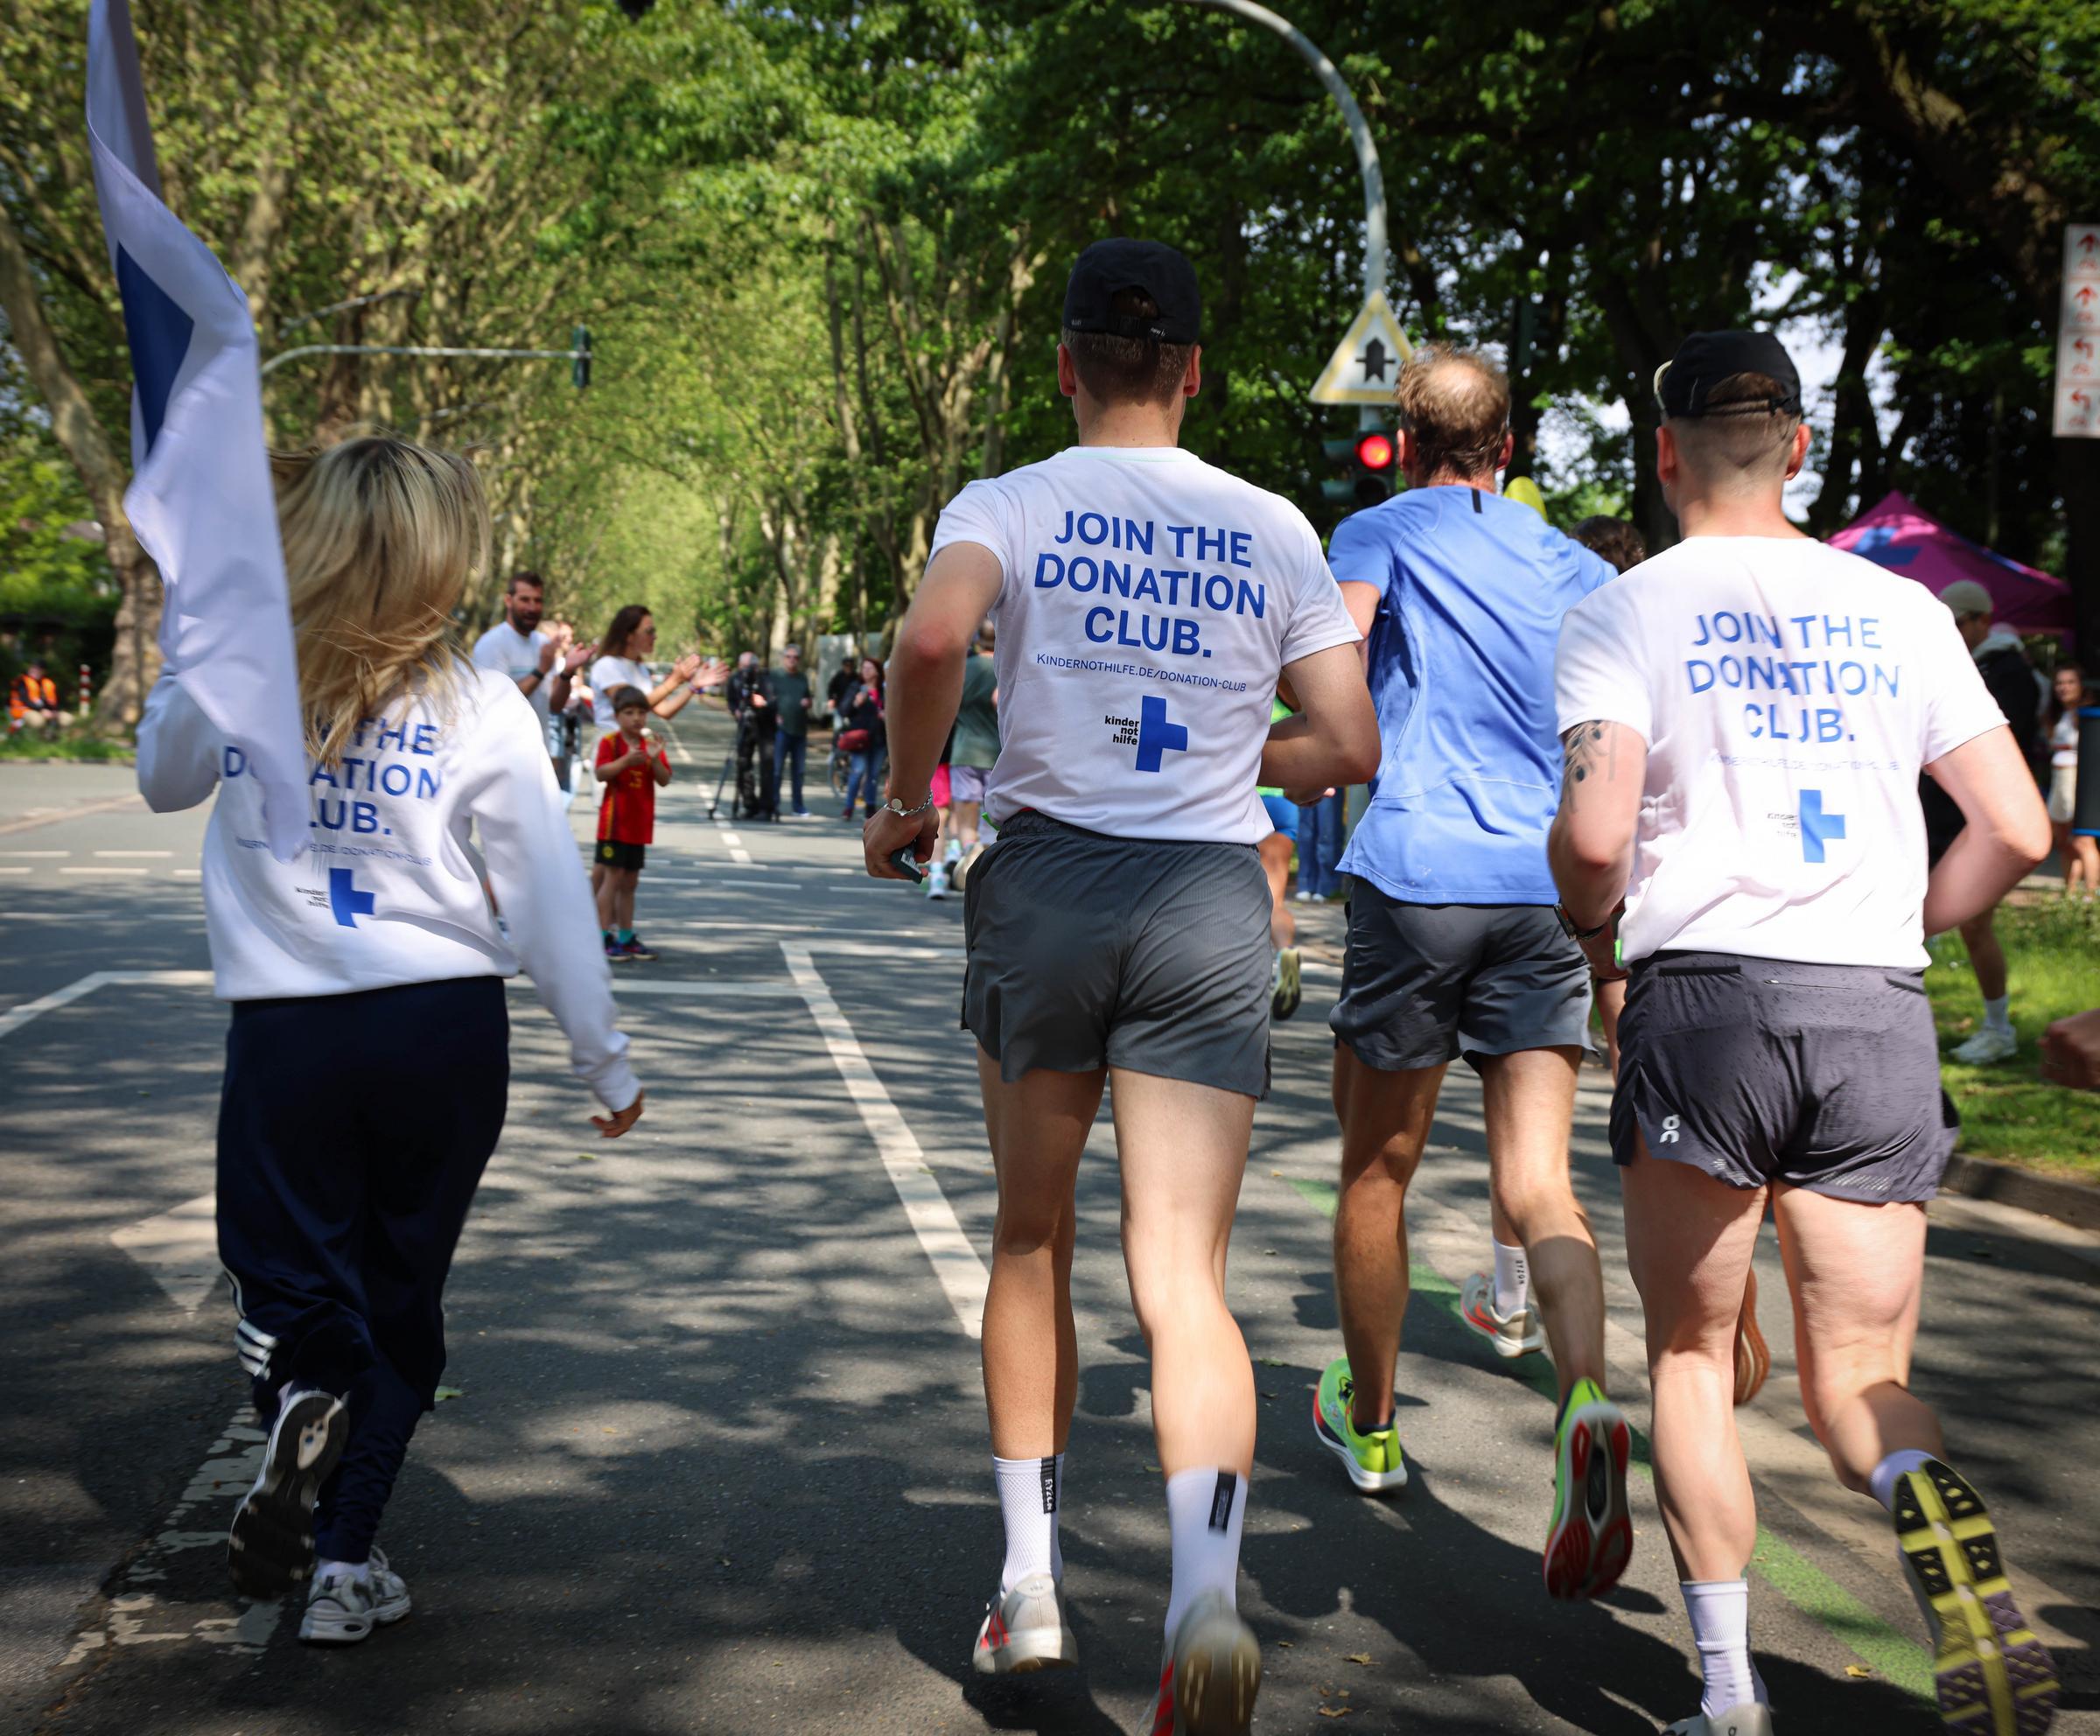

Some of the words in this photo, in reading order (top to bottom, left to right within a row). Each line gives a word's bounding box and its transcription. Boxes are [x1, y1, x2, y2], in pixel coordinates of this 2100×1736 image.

[1054, 510, 1154, 555] JOIN
[1166, 525, 1252, 568] THE
[1034, 553, 1265, 619] DONATION
[1085, 606, 1211, 658] CLUB.
[1692, 611, 1782, 649] JOIN
[1791, 615, 1882, 649] THE
[1037, 654, 1247, 692] KINDERNOTHILFE.DE/DONATION-CLUB
[1686, 654, 1900, 698] DONATION
[1104, 715, 1139, 727] kinder
[1113, 733, 1138, 745] hilfe
[1121, 727, 1138, 736] not
[224, 746, 441, 798] DATION
